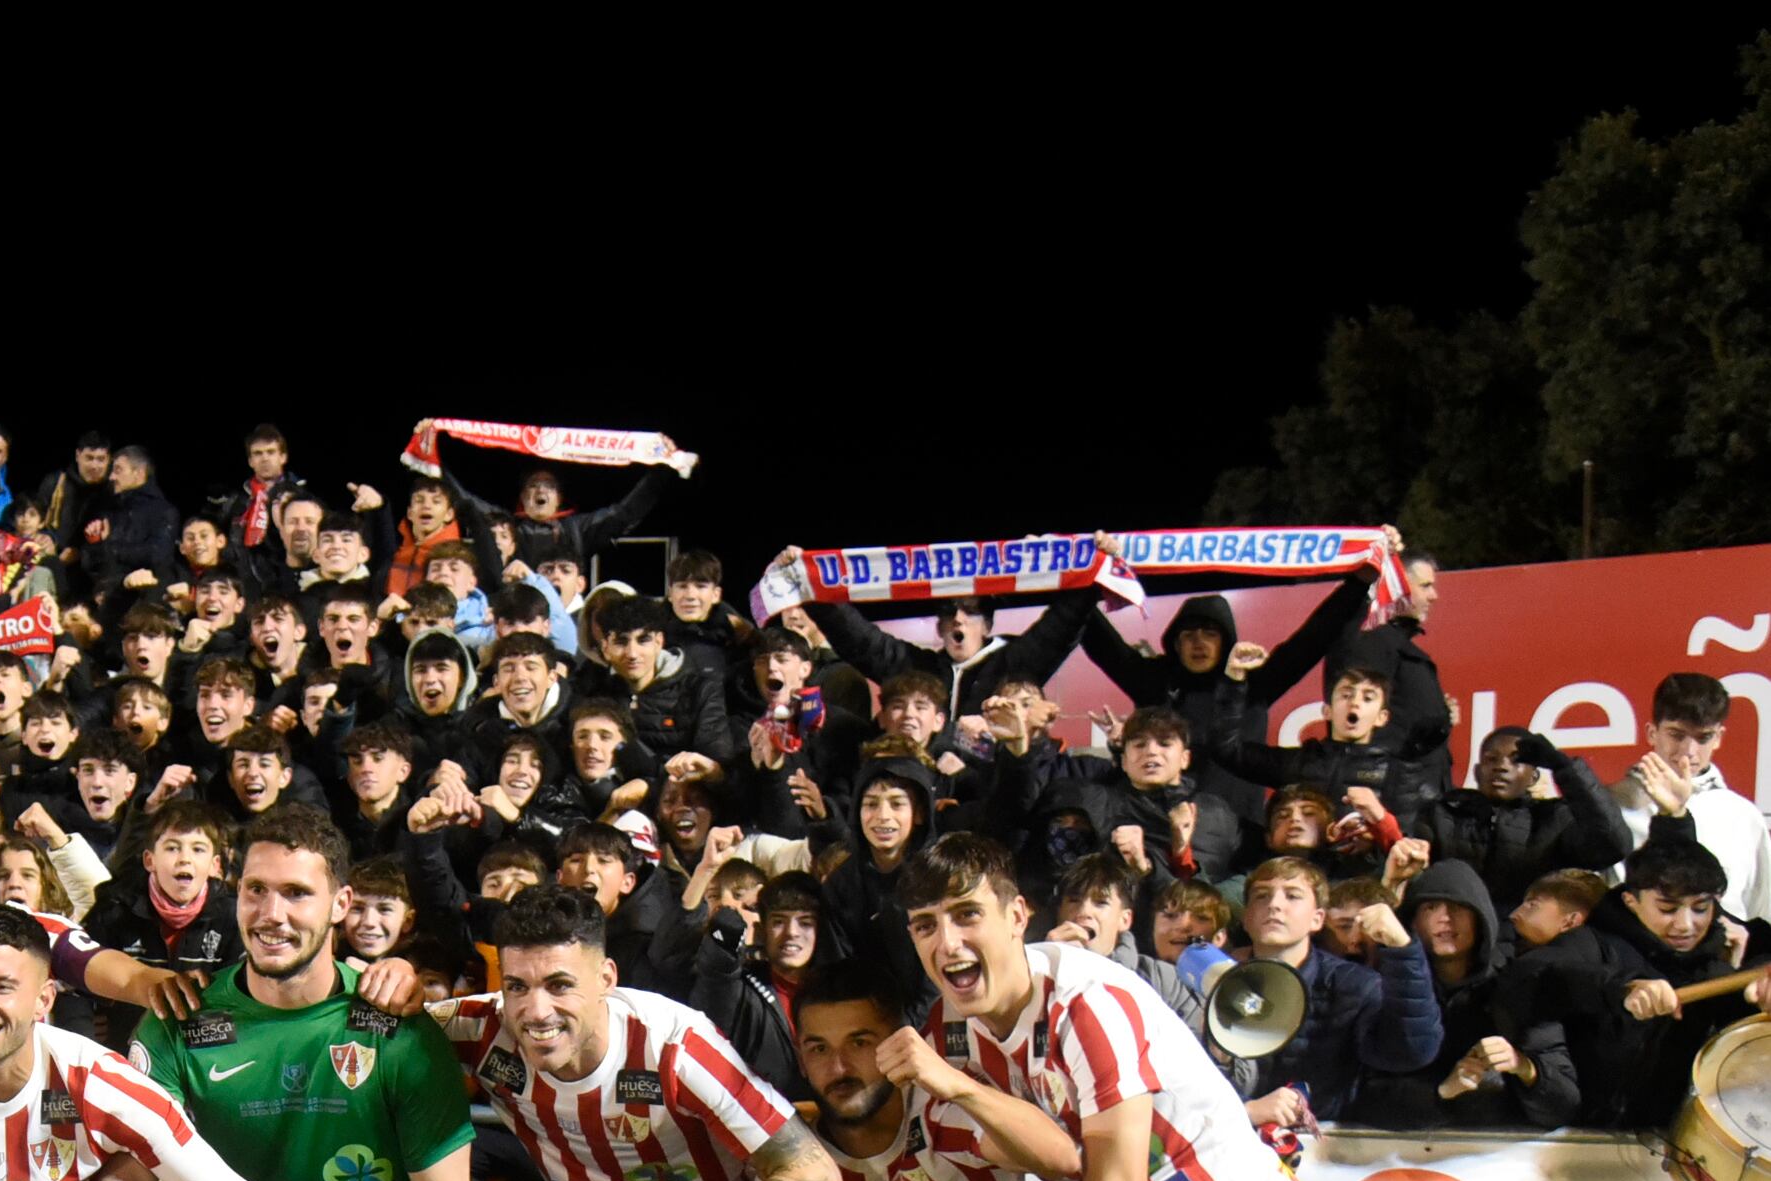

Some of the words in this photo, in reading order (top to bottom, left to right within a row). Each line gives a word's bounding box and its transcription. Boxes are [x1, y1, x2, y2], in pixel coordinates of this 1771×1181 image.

[1157, 533, 1342, 564] BARBASTRO
[817, 552, 880, 587] U.D.
[888, 538, 1096, 583] BARBASTRO
[351, 1009, 399, 1028] Huesca
[182, 1021, 234, 1039] Huesca
[619, 1079, 662, 1093] Huesca
[43, 1099, 76, 1112] Hues
